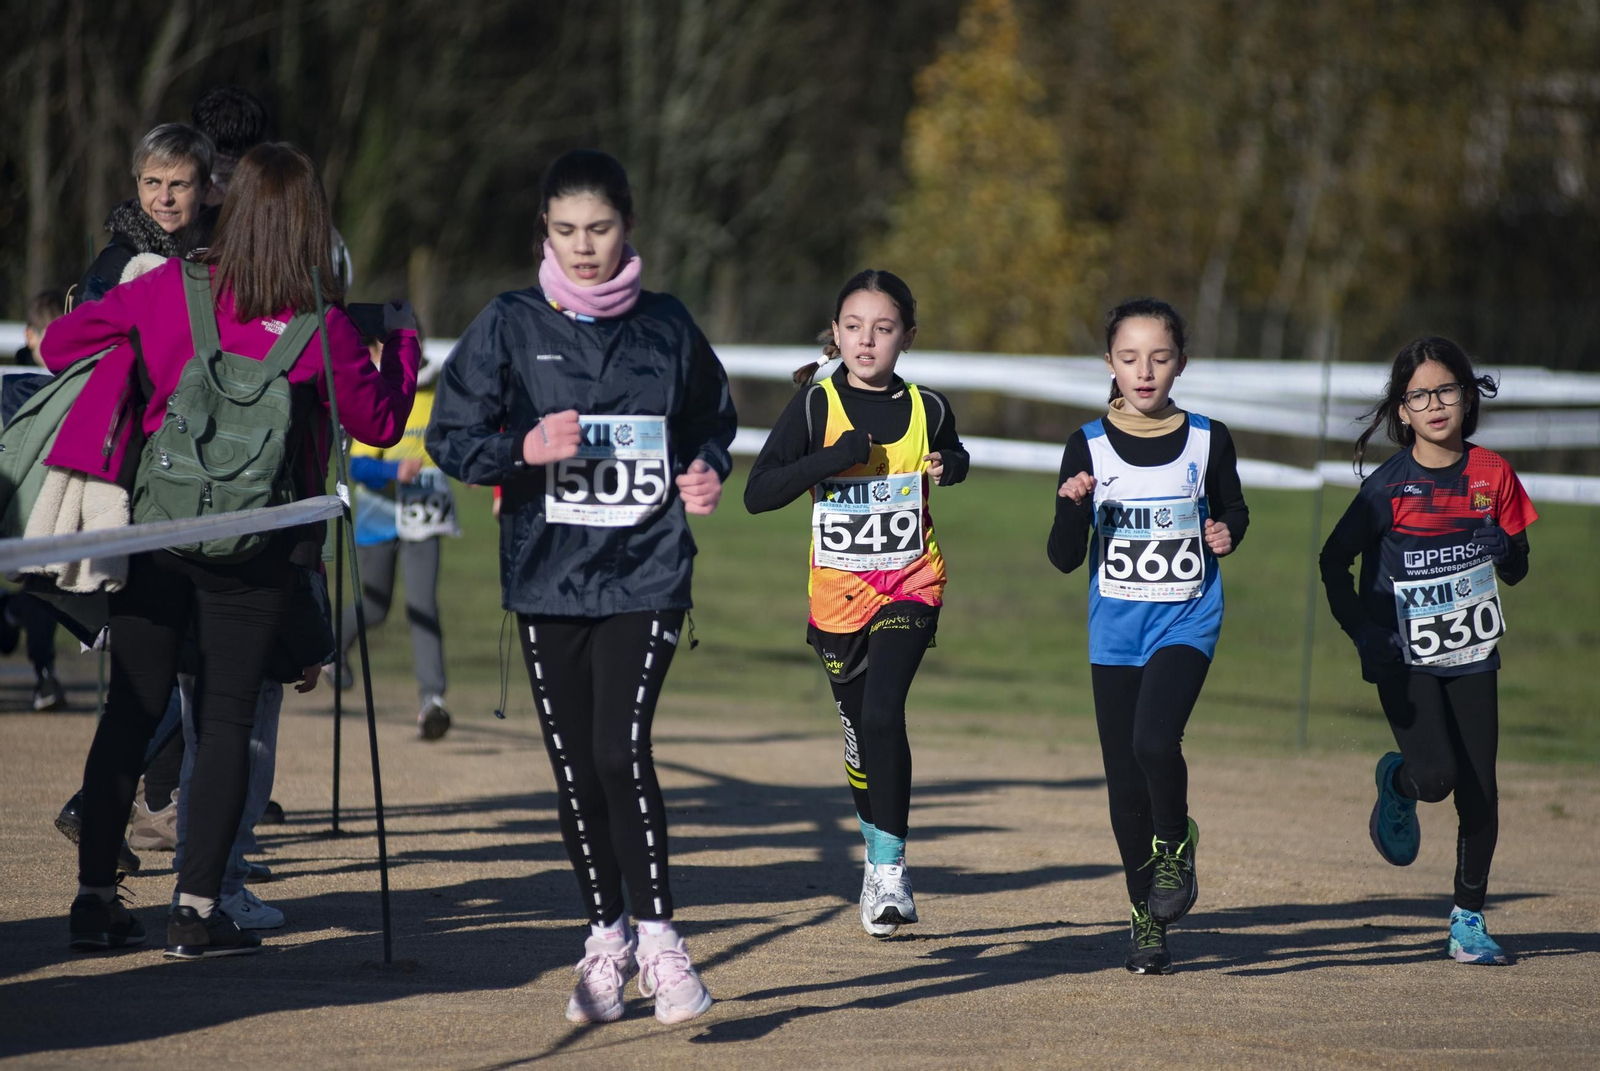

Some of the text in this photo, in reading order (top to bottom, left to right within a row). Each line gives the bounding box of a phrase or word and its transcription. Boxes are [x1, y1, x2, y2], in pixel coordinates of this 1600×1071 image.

[579, 423, 610, 446] XII
[556, 460, 665, 504] 505
[819, 482, 869, 504] XXII
[823, 511, 917, 551] 549
[1102, 506, 1150, 529] XXII
[1107, 539, 1200, 581] 566
[1426, 542, 1488, 566] PERSA
[1401, 582, 1453, 609] XXII
[1410, 600, 1500, 656] 530
